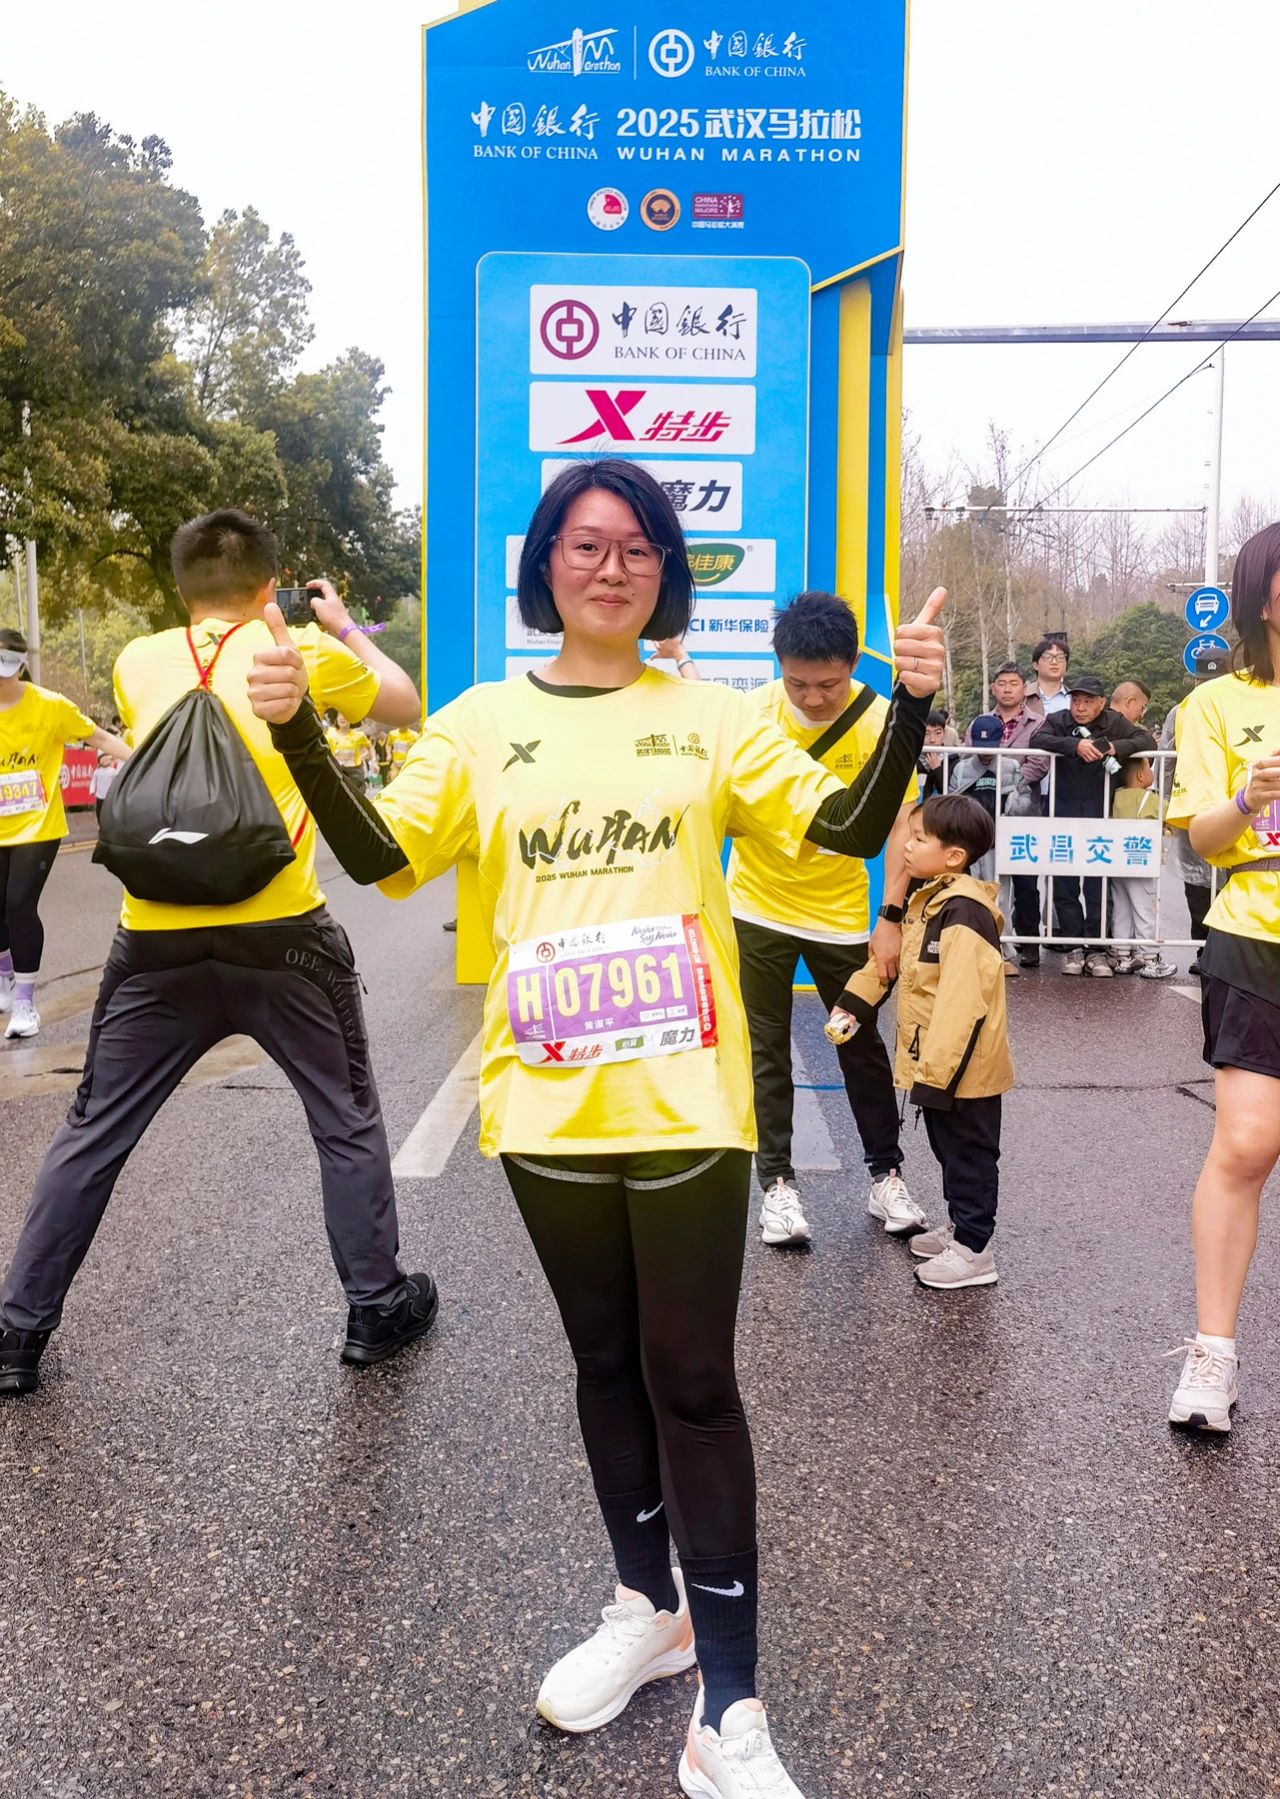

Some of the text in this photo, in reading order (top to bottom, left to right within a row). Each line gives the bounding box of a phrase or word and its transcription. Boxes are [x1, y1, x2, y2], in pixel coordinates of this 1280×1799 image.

[705, 66, 806, 77] BANK OF CHINA
[473, 145, 598, 160] BANK OF CHINA
[616, 146, 861, 162] WUHAN MARATHON
[695, 196, 718, 204] CHINA
[614, 346, 746, 361] BANK OF CHINA
[639, 410, 731, 443] 特步
[661, 479, 732, 513] 魔力
[688, 618, 769, 633] CI 新华保险
[1009, 833, 1153, 866] 武昌交警
[535, 866, 634, 883] 2025 WUHAN MARATHON
[516, 972, 545, 1023] H
[554, 952, 684, 1017] 07961
[660, 1027, 695, 1046] 魔力
